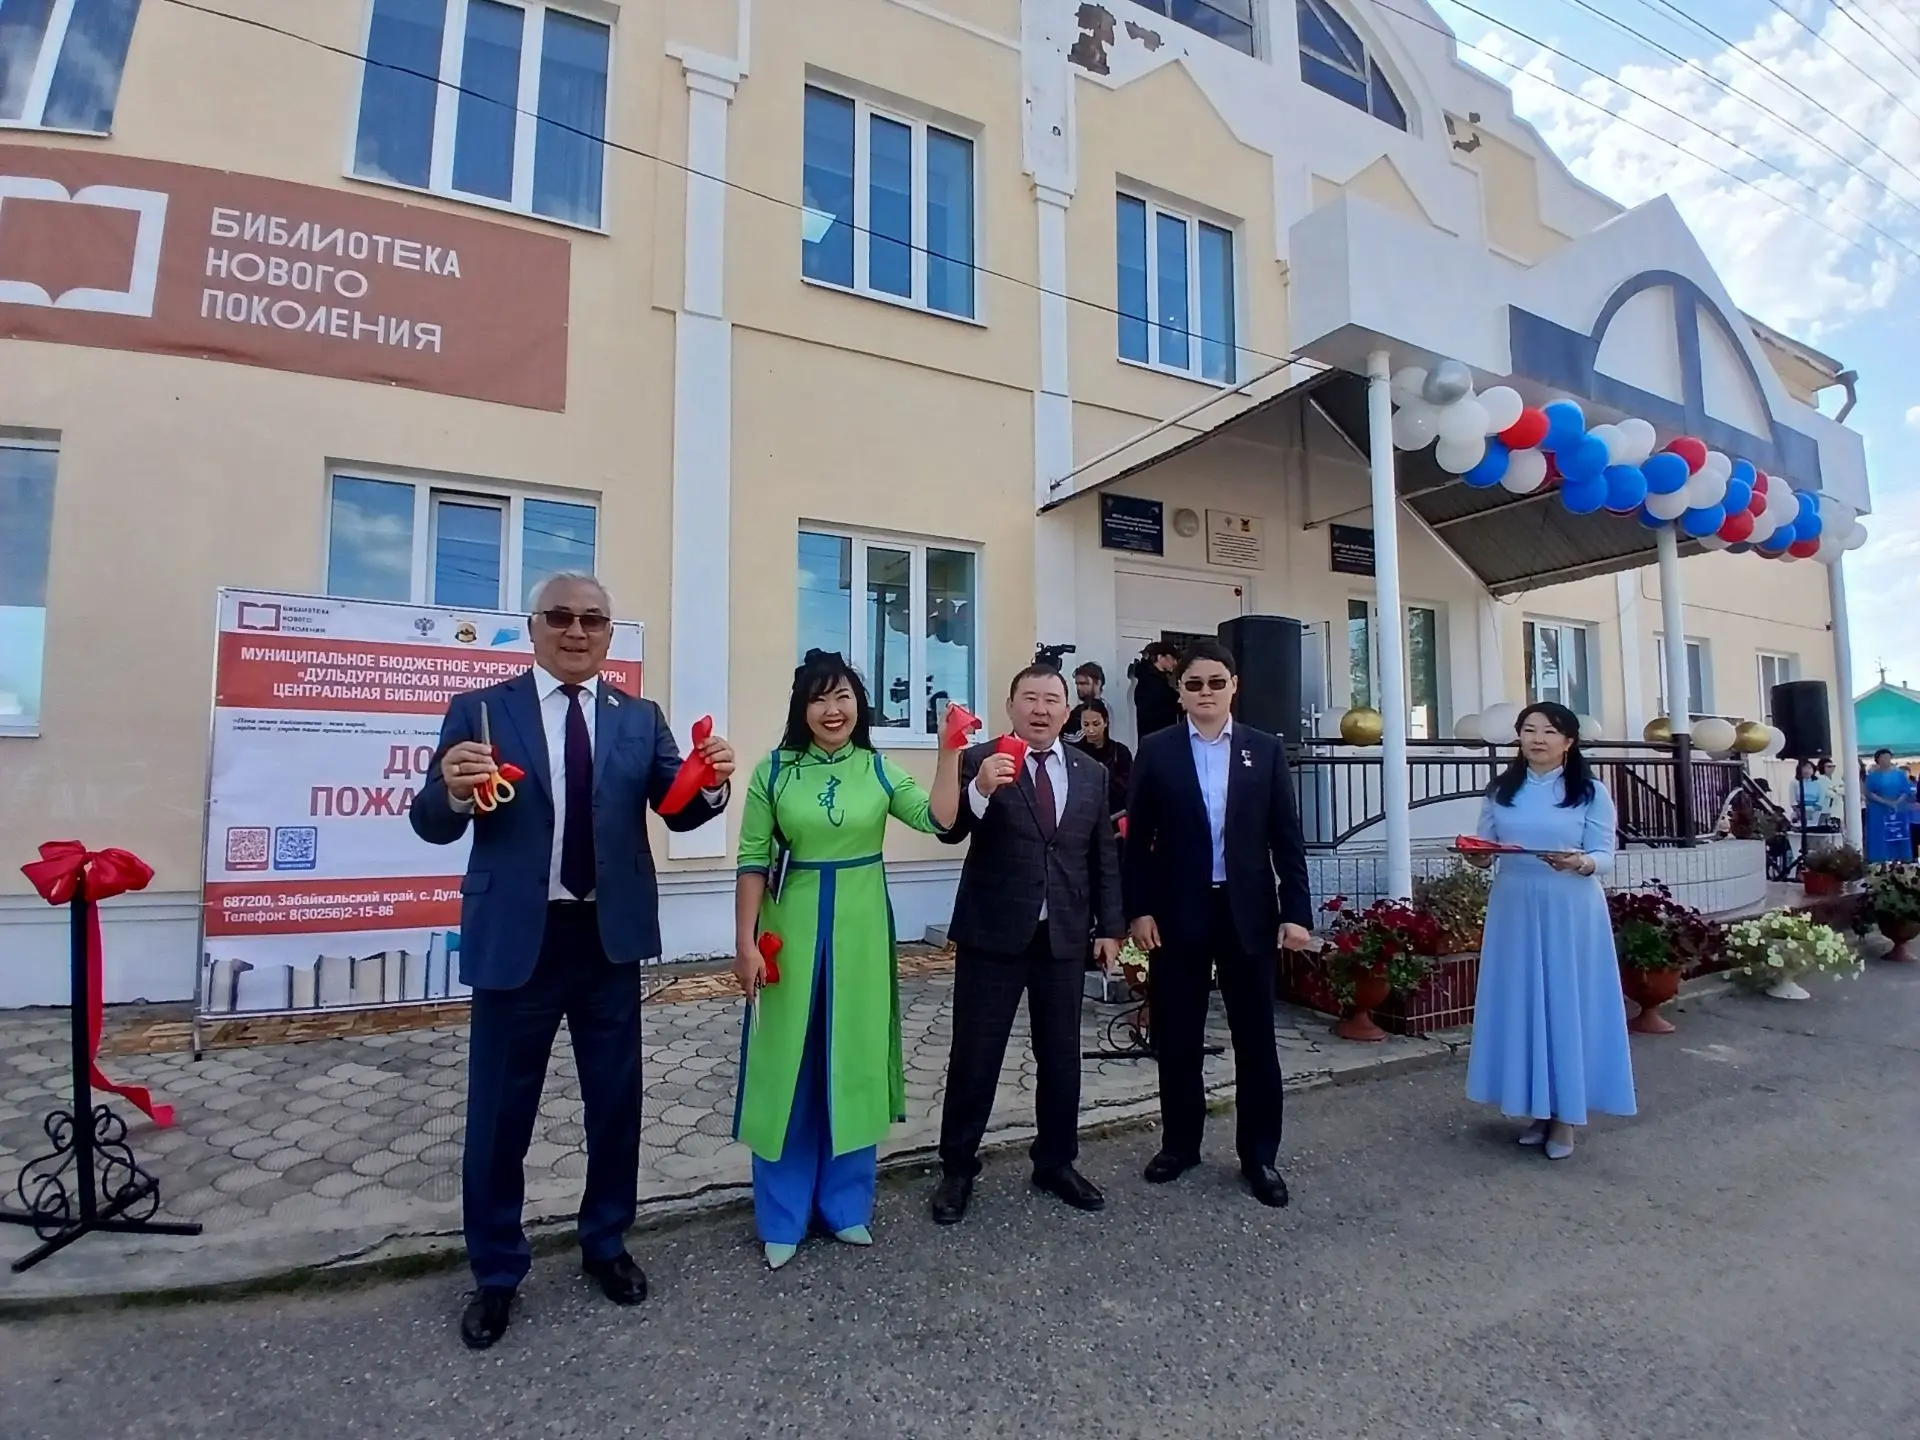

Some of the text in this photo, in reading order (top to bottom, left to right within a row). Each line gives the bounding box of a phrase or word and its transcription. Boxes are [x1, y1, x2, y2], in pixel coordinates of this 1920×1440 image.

[210, 206, 461, 279] БИБЛИОТЕКА
[206, 246, 368, 299] НОВОГО
[200, 288, 443, 354] ПОКОЛЕНИЯ
[240, 646, 375, 667] МУНИЦИПАЛЬНОЕ
[379, 655, 470, 673] БЮДЖЕТНОЕ
[473, 661, 532, 677] УЧРЕЖД
[297, 668, 439, 686] «ДУЛЬДУРГИНСКАЯ
[273, 683, 461, 703] ЦЕНТРАЛЬНАЯ БИБЛИОТ
[223, 894, 274, 908] 687200,
[278, 891, 380, 906] Забайкальский
[384, 889, 417, 904] край,
[420, 891, 430, 900] с.
[223, 905, 394, 923] Телефон: 8(30256)2-15-86
